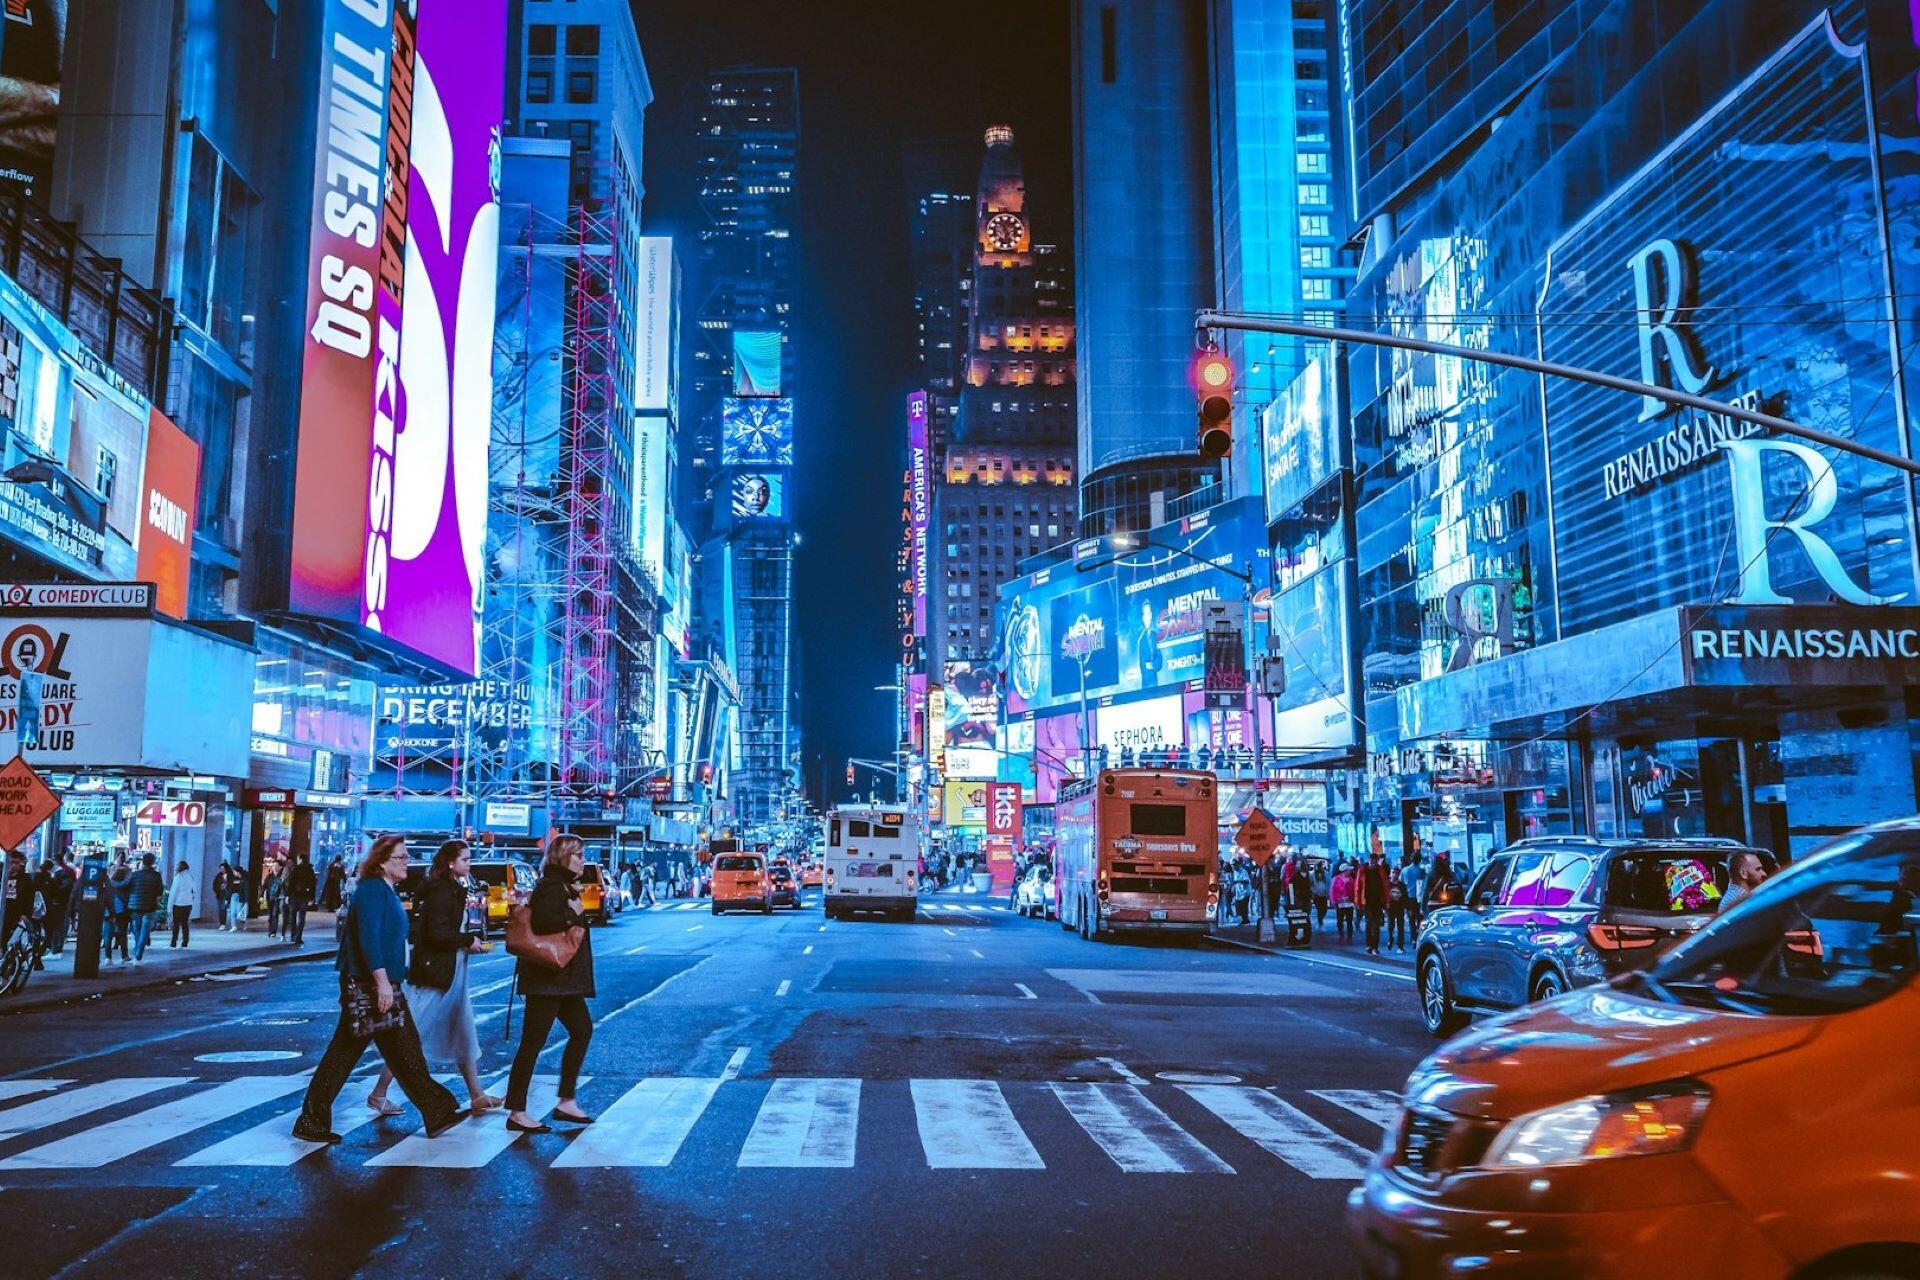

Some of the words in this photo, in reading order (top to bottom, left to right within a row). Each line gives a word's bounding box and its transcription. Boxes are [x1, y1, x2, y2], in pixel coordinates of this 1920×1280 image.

[324, 32, 386, 248] TIMES
[311, 254, 374, 359] SQ
[1626, 238, 1716, 424] R
[1603, 390, 1764, 500] RENAISSANCE
[913, 447, 926, 522] AMERICA'S
[1717, 439, 1908, 606] R
[1168, 586, 1221, 614] MENTAL
[0, 624, 72, 680] OL
[1691, 629, 1919, 659] RENAISSANC
[42, 684, 77, 699] UARE
[384, 698, 533, 730] DECEMBER
[1114, 725, 1163, 747] SEPHORA
[0, 776, 32, 789] ROAD
[66, 807, 111, 815] LUGGAGE
[994, 786, 1017, 830] tkts
[1114, 840, 1142, 848] TACOMA
[89, 869, 98, 879] P
